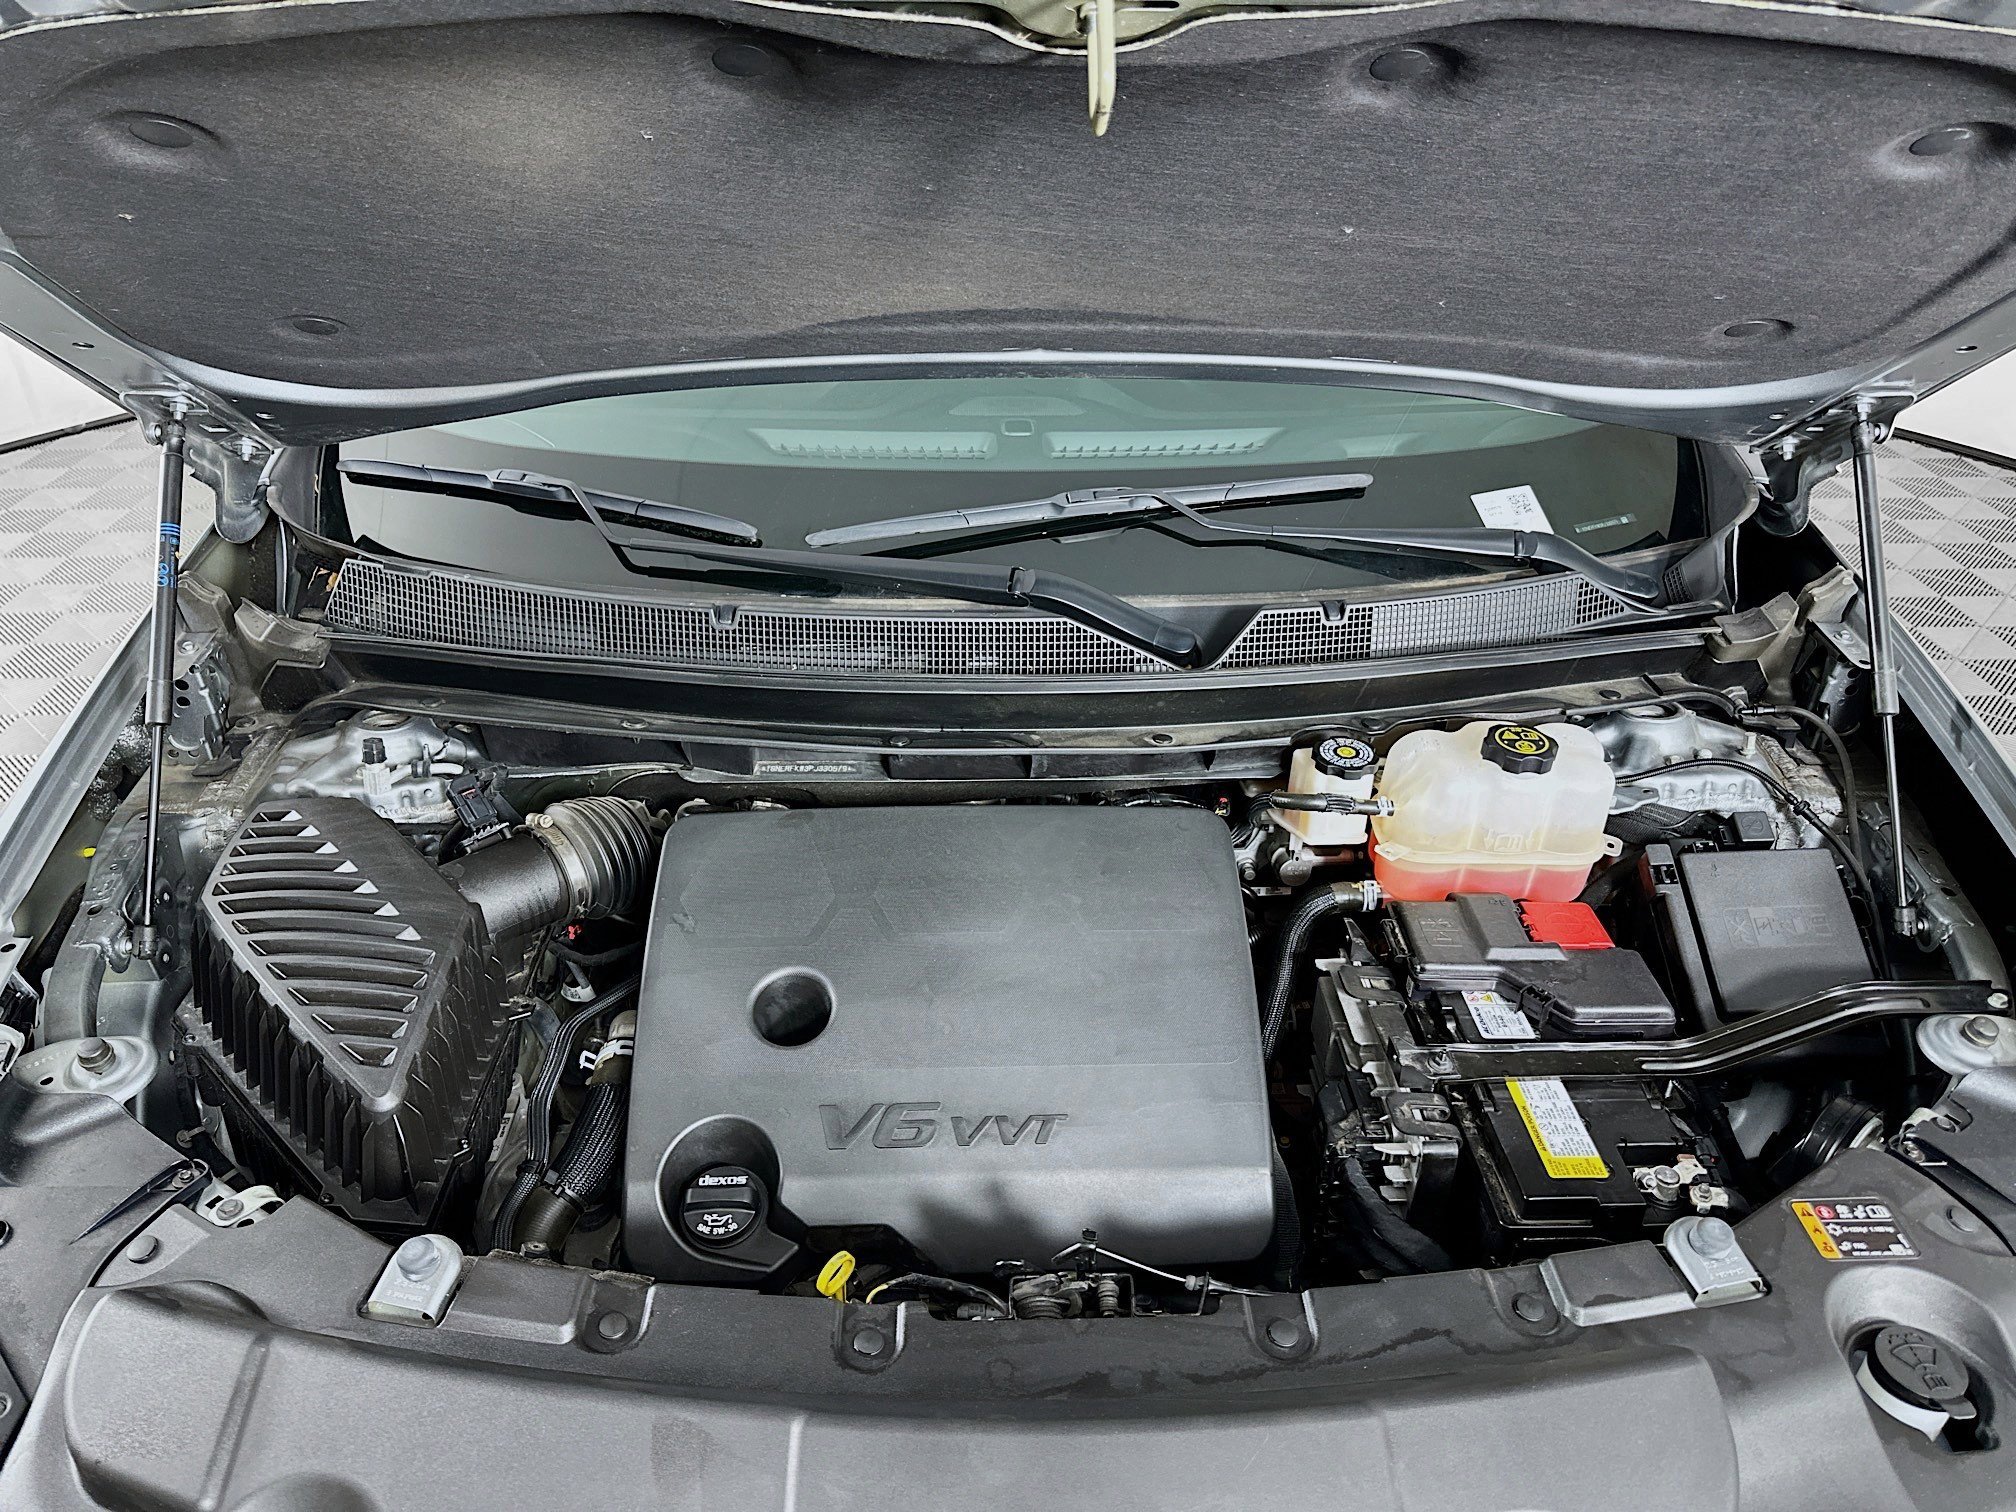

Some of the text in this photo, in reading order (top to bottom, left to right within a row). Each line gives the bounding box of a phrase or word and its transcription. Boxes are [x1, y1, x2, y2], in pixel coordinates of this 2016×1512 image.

[819, 1102, 1068, 1150] V6 VVT
[699, 1175, 749, 1186] dexos
[697, 1222, 738, 1235] SAE 5W-30
